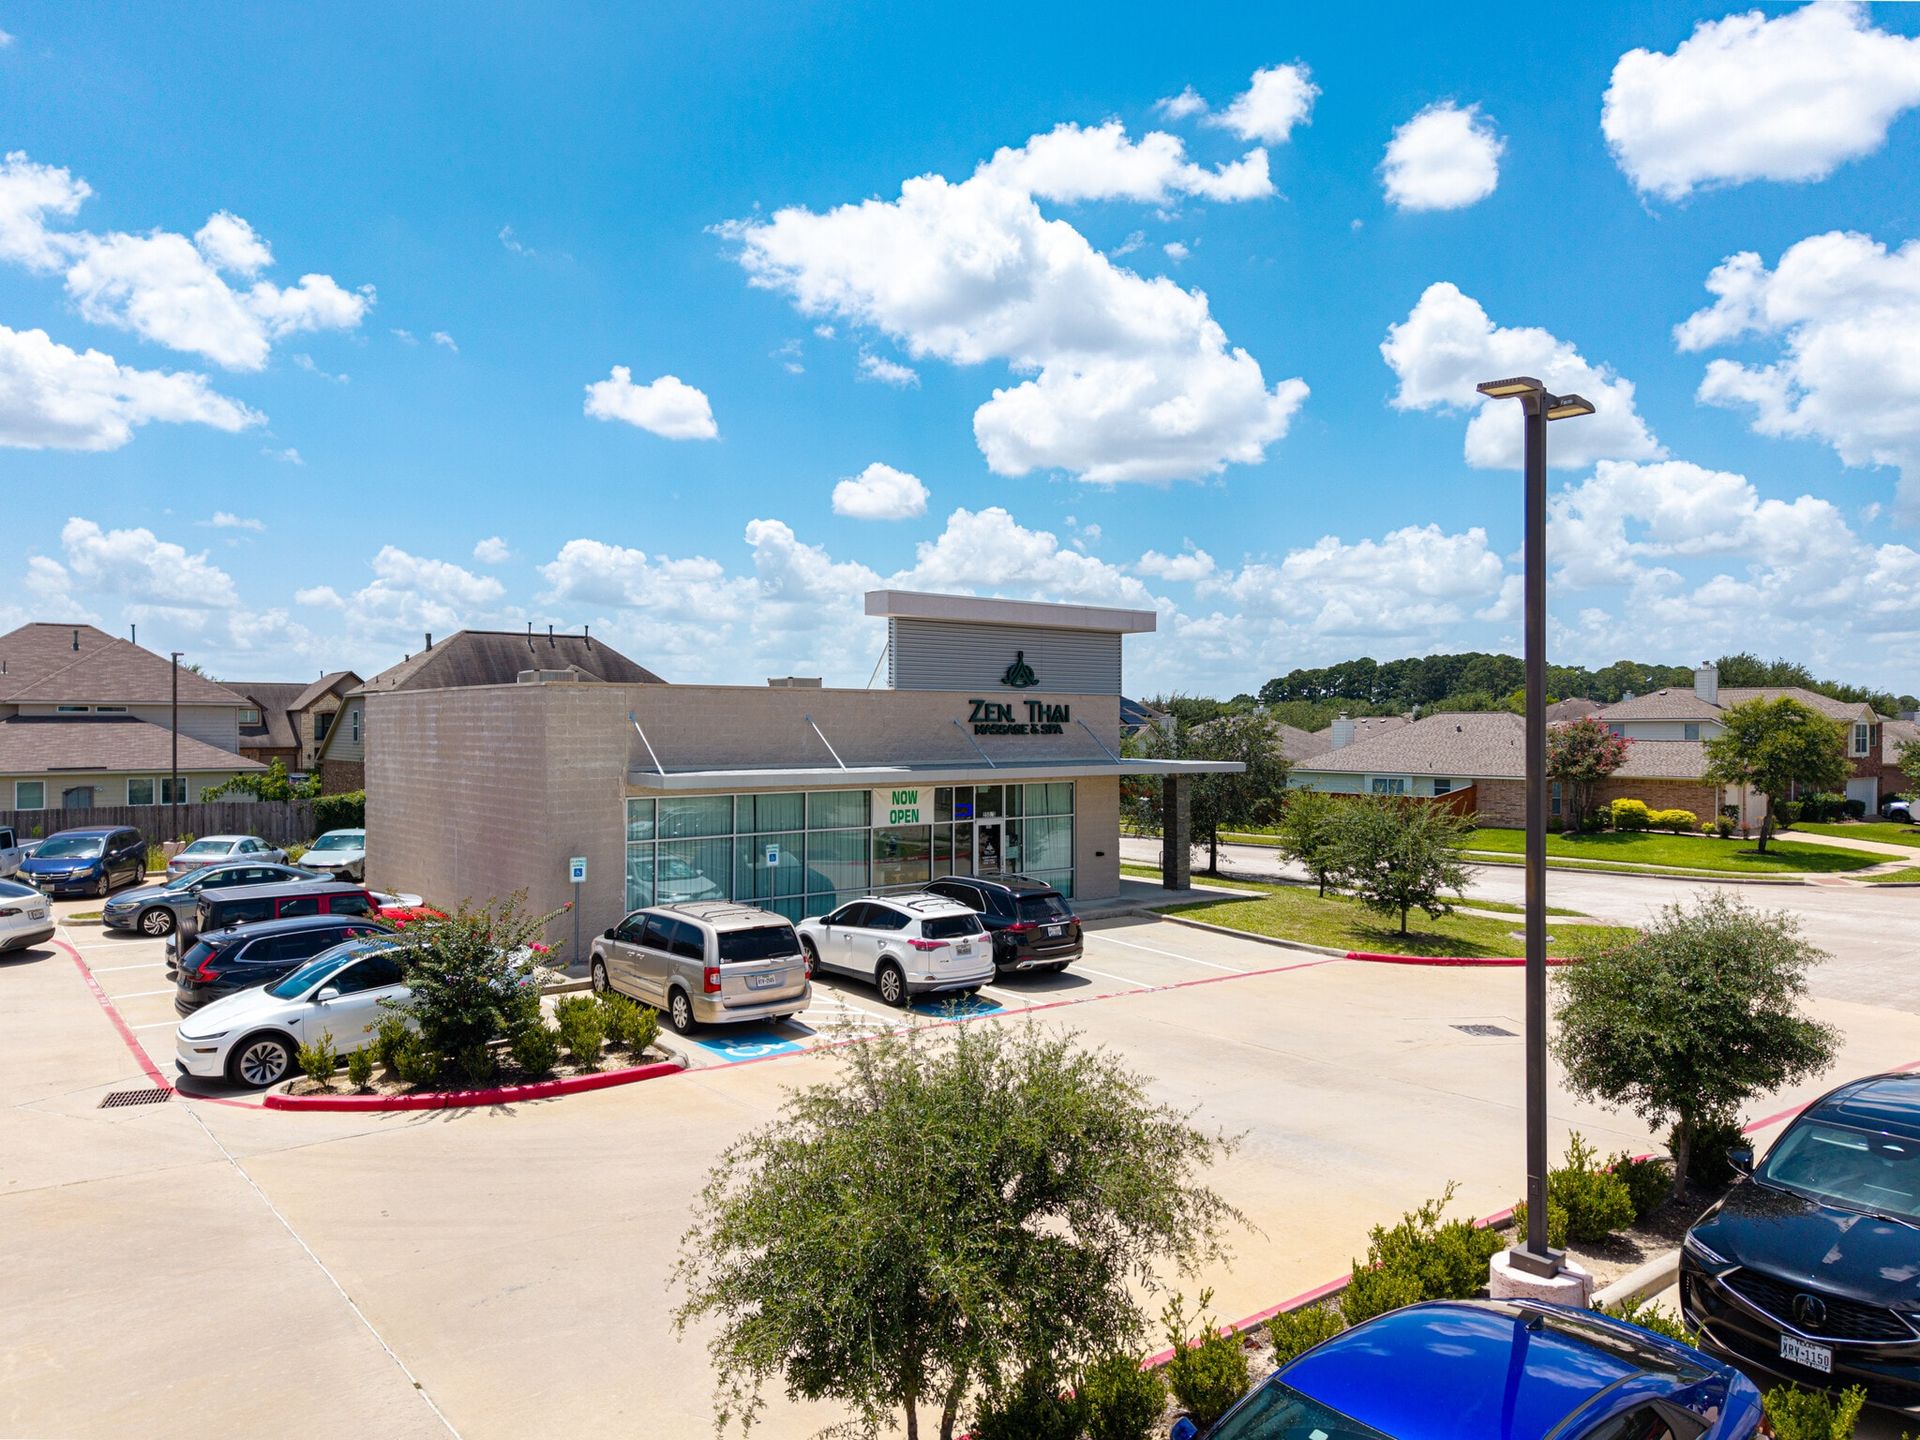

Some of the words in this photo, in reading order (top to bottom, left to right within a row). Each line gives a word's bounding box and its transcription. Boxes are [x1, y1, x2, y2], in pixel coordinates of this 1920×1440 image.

[1023, 700, 1071, 723] THAI
[974, 723, 1030, 735] MASSAGE
[1030, 723, 1040, 735] &
[1040, 723, 1064, 735] SPA
[892, 790, 918, 805] NOW
[890, 808, 919, 825] OPEN
[1782, 1342, 1830, 1367] XRV-1150
